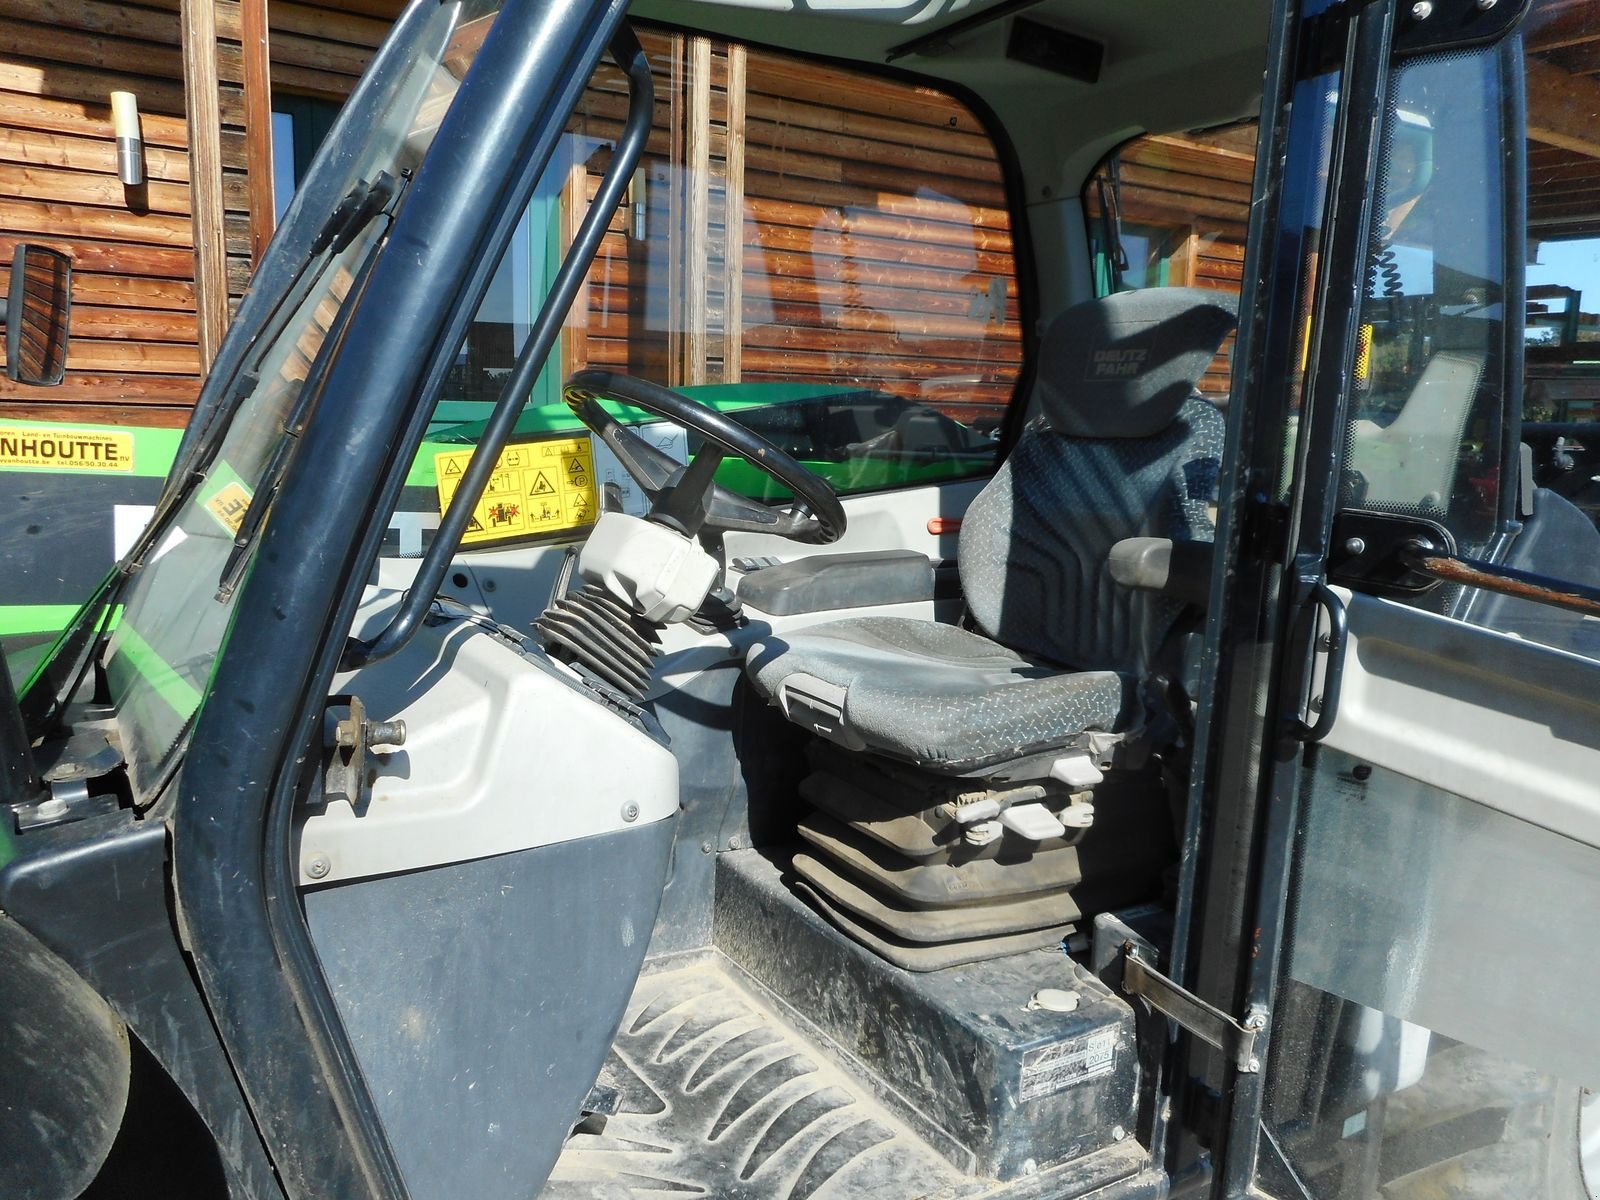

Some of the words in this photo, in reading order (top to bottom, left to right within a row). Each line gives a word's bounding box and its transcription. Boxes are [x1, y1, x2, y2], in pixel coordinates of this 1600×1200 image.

[1094, 348, 1147, 362] DEUTZ
[1096, 363, 1139, 376] FAHR
[53, 432, 112, 441] Tuinbouwmachines
[1, 438, 118, 460] NHOUTTE
